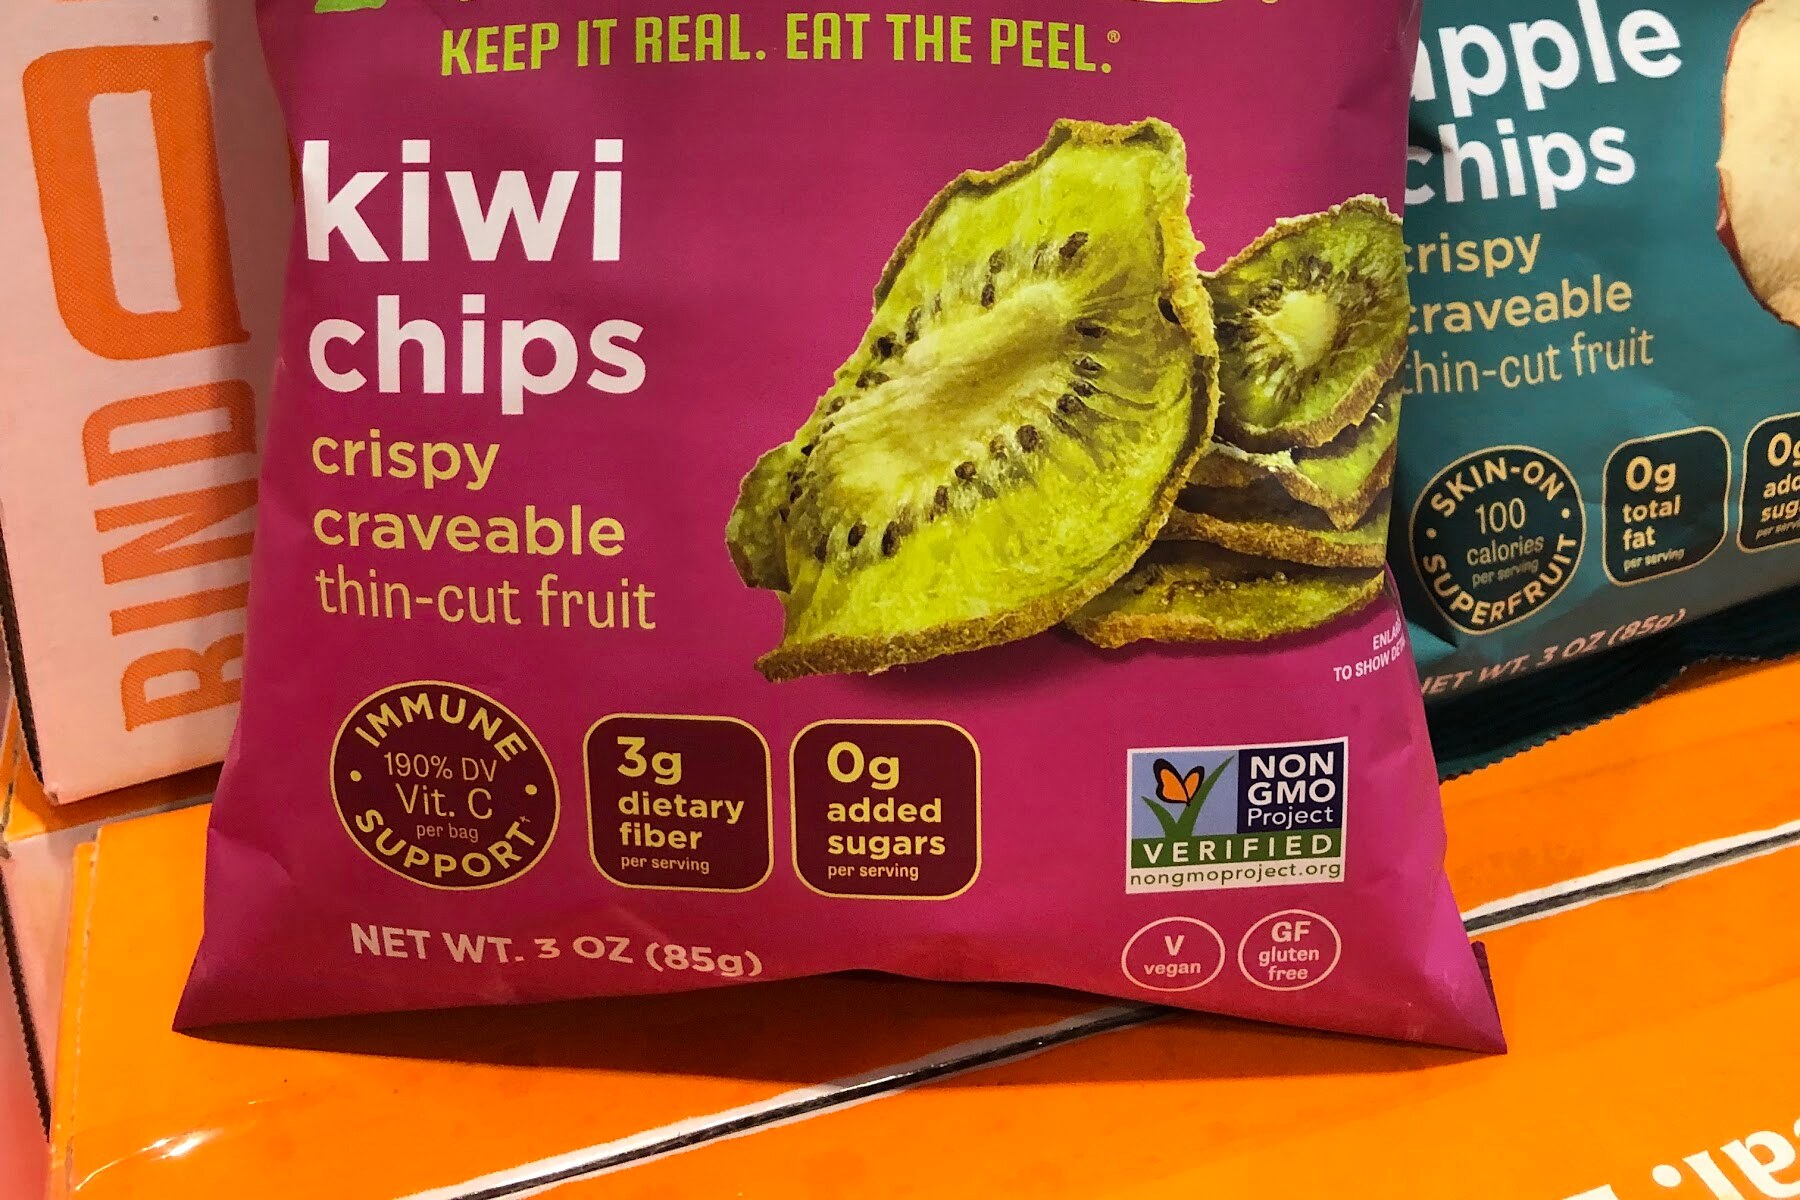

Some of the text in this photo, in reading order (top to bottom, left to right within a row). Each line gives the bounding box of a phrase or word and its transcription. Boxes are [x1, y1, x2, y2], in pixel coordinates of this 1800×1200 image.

[440, 15, 561, 77] KEEP
[576, 16, 614, 68] IT
[634, 12, 768, 64] REAL.
[785, 11, 872, 62] EAT
[891, 12, 975, 66] THE
[302, 138, 624, 263] kiwi
[308, 293, 648, 416] chips
[1570, 325, 1655, 378] fruit
[311, 428, 501, 491] crispy
[1625, 455, 1677, 494] 0g
[1430, 456, 1566, 518] SKIN-ON
[1474, 497, 1527, 535] 100
[1622, 494, 1682, 524] total
[1760, 498, 1800, 523] sug
[313, 504, 626, 558] craveable
[1622, 525, 1657, 551] fat
[1466, 535, 1546, 567] calories
[1623, 548, 1686, 574] per serving
[1423, 532, 1577, 626] SUPERFRUIT
[1471, 557, 1541, 590] per serving
[315, 562, 657, 631] thin-cut fruit
[1535, 645, 1559, 669] 3
[1561, 629, 1608, 660] OZ
[1333, 665, 1353, 682] TO
[1355, 649, 1391, 678] SHOW
[354, 691, 528, 764] IMMUNE
[383, 751, 499, 783] 190% DV
[616, 735, 684, 787] 3g
[825, 740, 902, 792] 0g
[1250, 752, 1334, 779] NON
[394, 782, 494, 821] Vit. C
[617, 789, 745, 825] dietary
[1247, 779, 1336, 806] GMO
[826, 796, 942, 825] added
[1247, 806, 1333, 829] Project
[416, 821, 480, 844] per bag
[618, 822, 703, 851] fiber
[826, 829, 948, 861] sugars
[1143, 834, 1332, 864] VERIFIED
[620, 854, 711, 877] per serving
[827, 861, 920, 883] per serving
[1131, 863, 1340, 887] nongmoproject.org
[1164, 935, 1185, 957] V
[1271, 920, 1311, 944] GF
[350, 922, 765, 979] NET WT. 3 OZ (85g)
[1258, 946, 1320, 967] gluten
[1143, 960, 1202, 977] vegan
[1267, 964, 1308, 982] free
